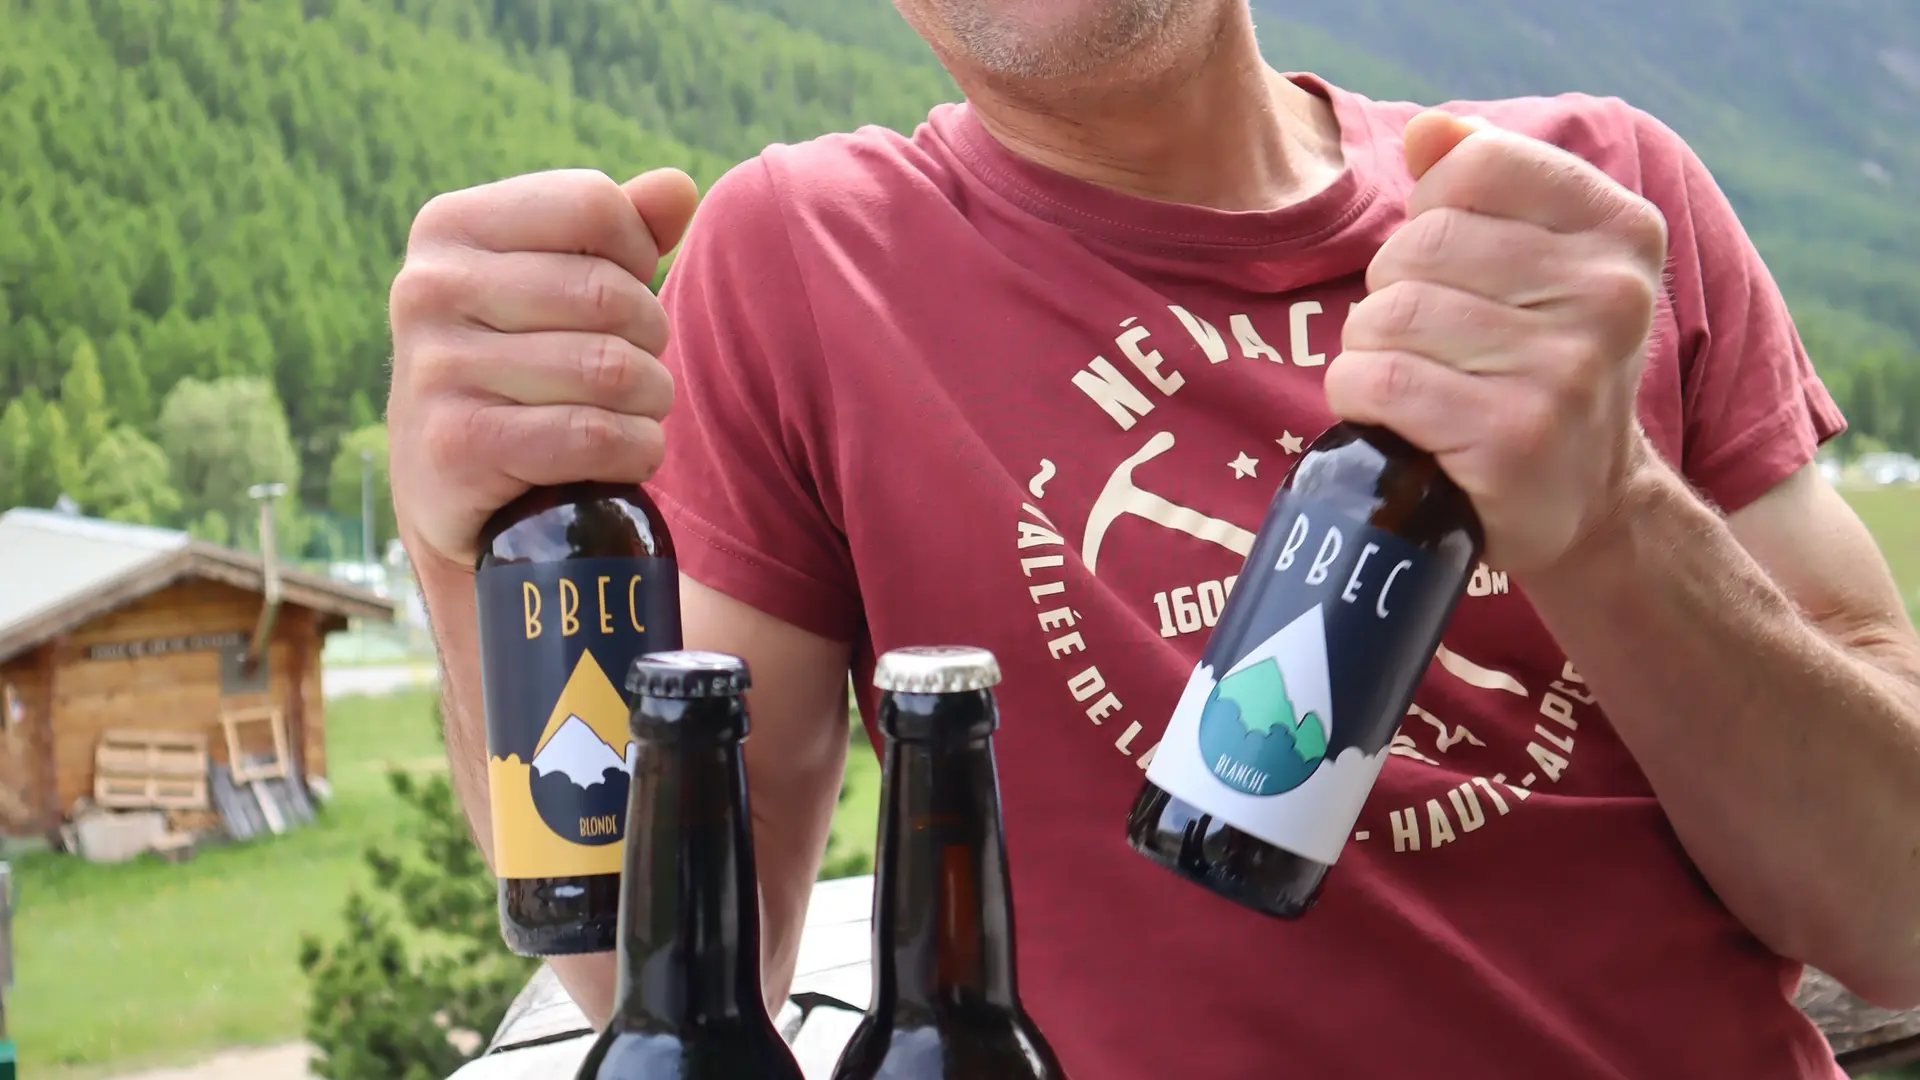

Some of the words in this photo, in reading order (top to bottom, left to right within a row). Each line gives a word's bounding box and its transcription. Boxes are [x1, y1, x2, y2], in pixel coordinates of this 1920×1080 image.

[1071, 301, 1359, 431] NÉVAC
[1274, 512, 1413, 619] BBEC
[522, 574, 645, 640] BBEC
[1153, 575, 1239, 638] 160
[1067, 665, 1123, 726] DE
[1213, 752, 1271, 795] BLANCHE
[579, 814, 618, 837] BLONDE
